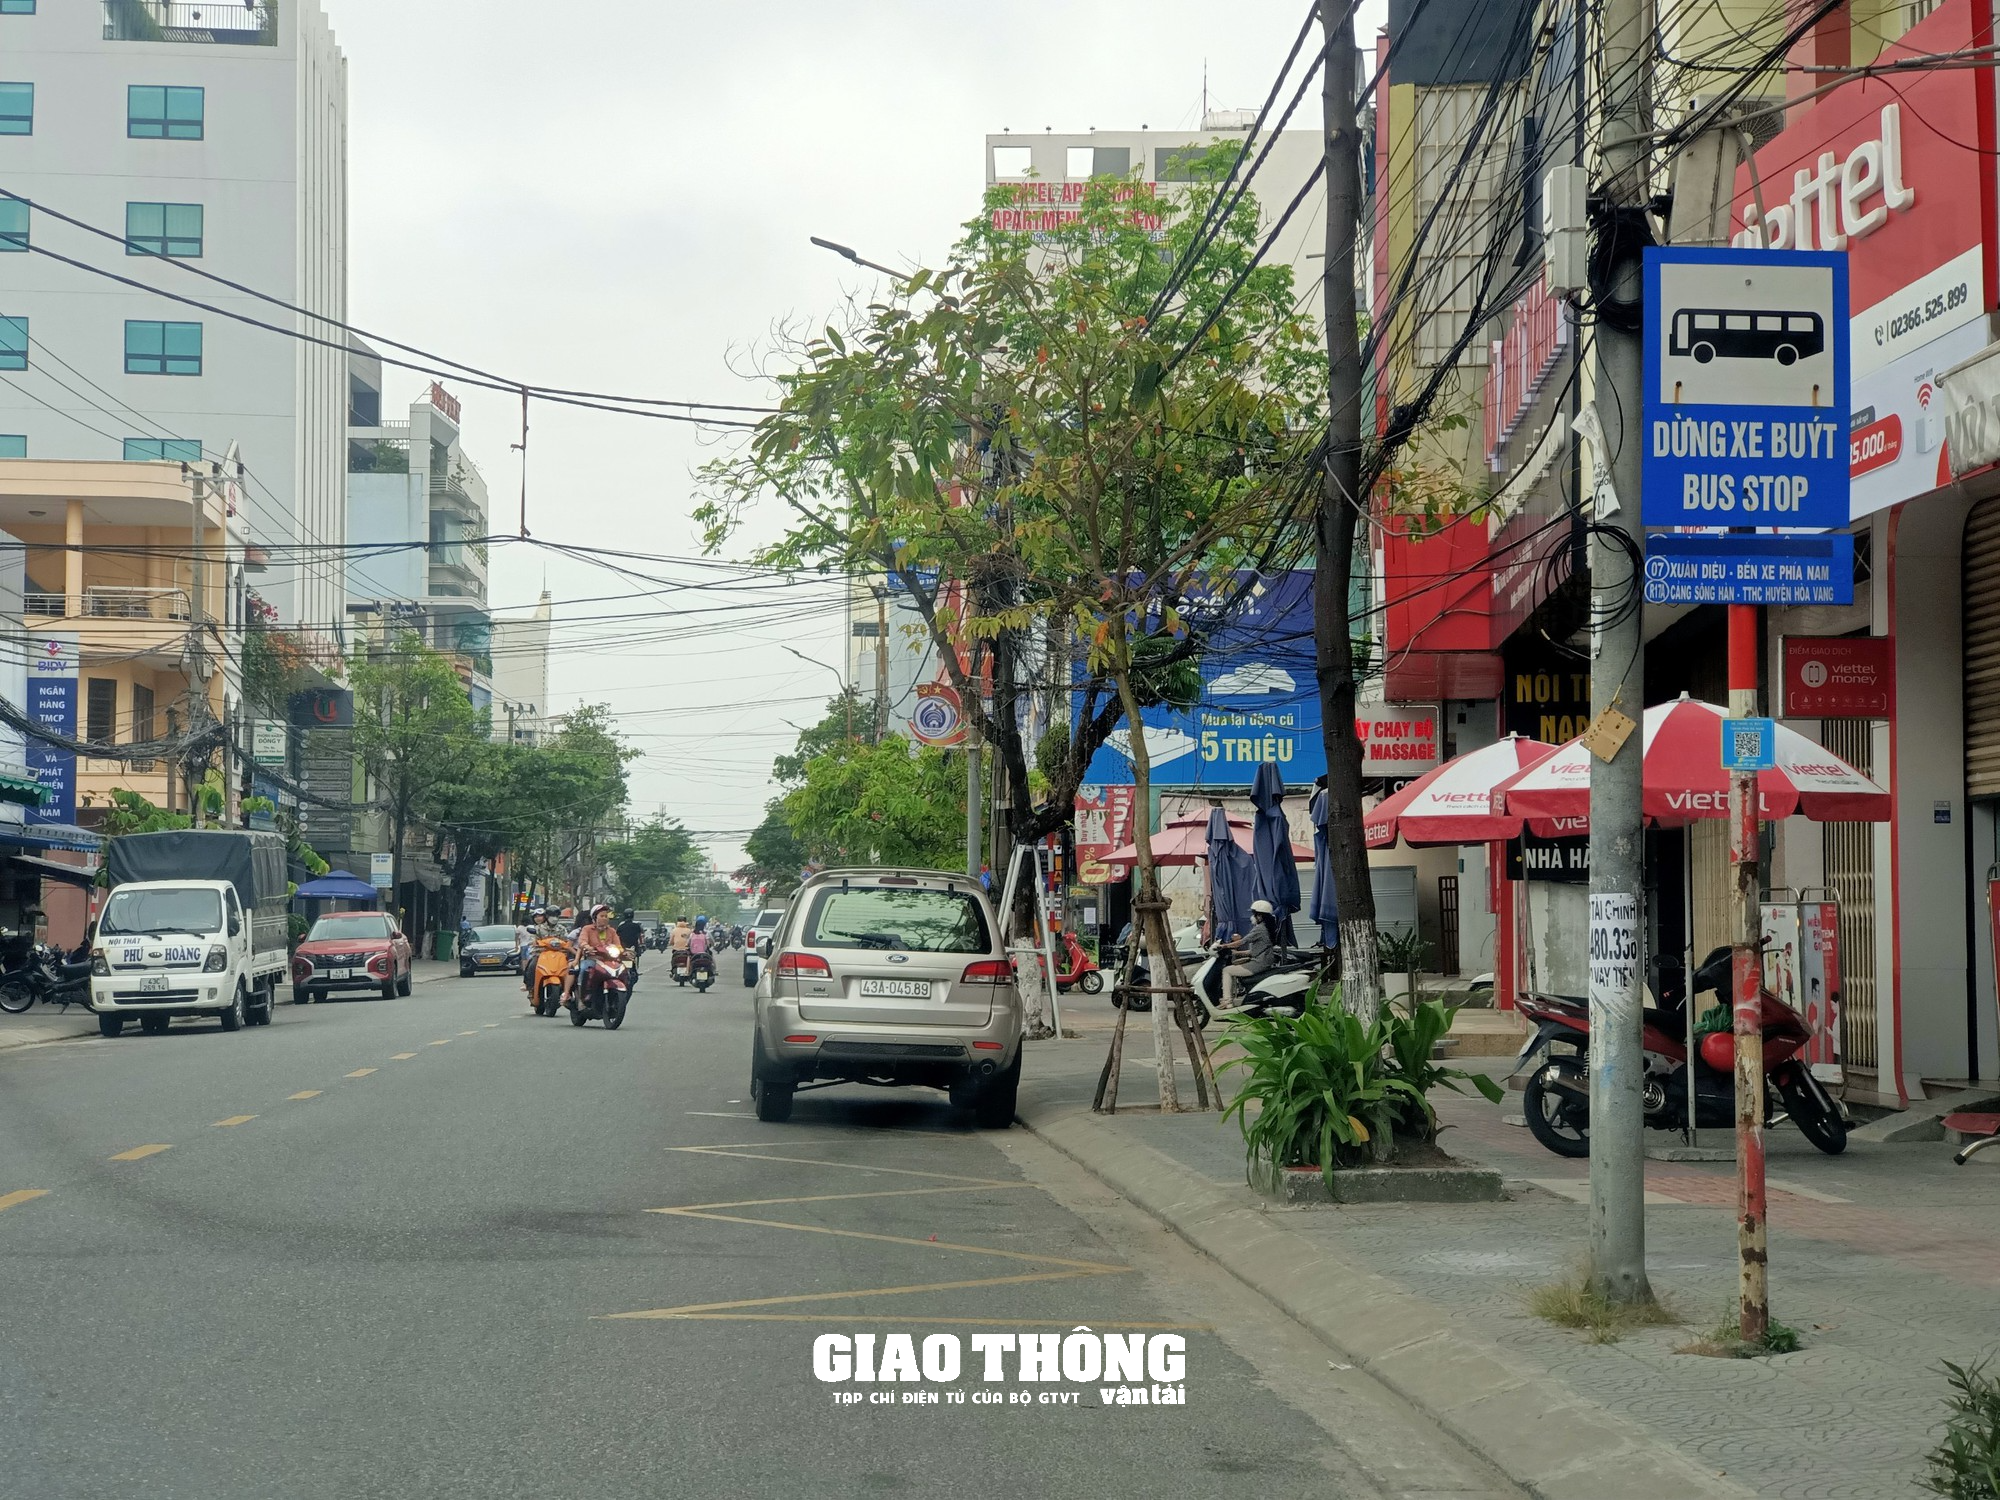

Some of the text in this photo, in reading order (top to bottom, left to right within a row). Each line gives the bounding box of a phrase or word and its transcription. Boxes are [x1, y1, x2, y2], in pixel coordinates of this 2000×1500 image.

[1731, 102, 1915, 251] iettel
[1891, 283, 1967, 340] 02366.525.899
[1653, 413, 1726, 458] DỪNG
[1730, 421, 1763, 458] XE
[1771, 415, 1837, 459] BUÝT
[1850, 430, 1885, 466] 5.000
[1683, 473, 1809, 512] BUS STOP
[1651, 562, 1664, 577] 07
[1702, 561, 1726, 582] DIỆU
[1737, 558, 1758, 580] BẾN
[1761, 565, 1775, 580] XE
[1779, 561, 1803, 581] PHÍA
[1806, 565, 1829, 581] NAM
[1649, 583, 1665, 600] R17A
[1670, 580, 1692, 600] CẢNG
[1694, 582, 1716, 601] SÔNG
[1718, 582, 1735, 601] HÀN
[1742, 586, 1763, 601] TTHC
[1765, 582, 1792, 604] HUYỆN
[1794, 583, 1811, 601] HÒA
[1813, 586, 1834, 602] VANG
[1811, 647, 1830, 655] GIAO
[38, 661, 67, 672] BIDV
[1832, 664, 1875, 674] viettel
[1516, 668, 1560, 708] NỘI
[1832, 675, 1877, 686] money
[39, 686, 65, 696] NGÂN
[39, 699, 65, 709] HÀNG
[40, 714, 64, 722] TMCP
[1201, 713, 1227, 726] Mua
[1279, 713, 1294, 726] cũ
[1374, 722, 1411, 741] CHẠY
[1414, 718, 1434, 741] BỘ
[1201, 731, 1219, 762] 5
[1370, 743, 1436, 760] MASSAGE
[45, 753, 57, 763] VÀ
[39, 766, 62, 776] PHÁT
[1784, 763, 1851, 777] viettel
[1665, 789, 1770, 812] vietl
[1552, 816, 1591, 830] vie
[1526, 843, 1563, 869] NHÀ
[165, 945, 201, 961] HOÀNG
[862, 980, 929, 996] 43A-045.89
